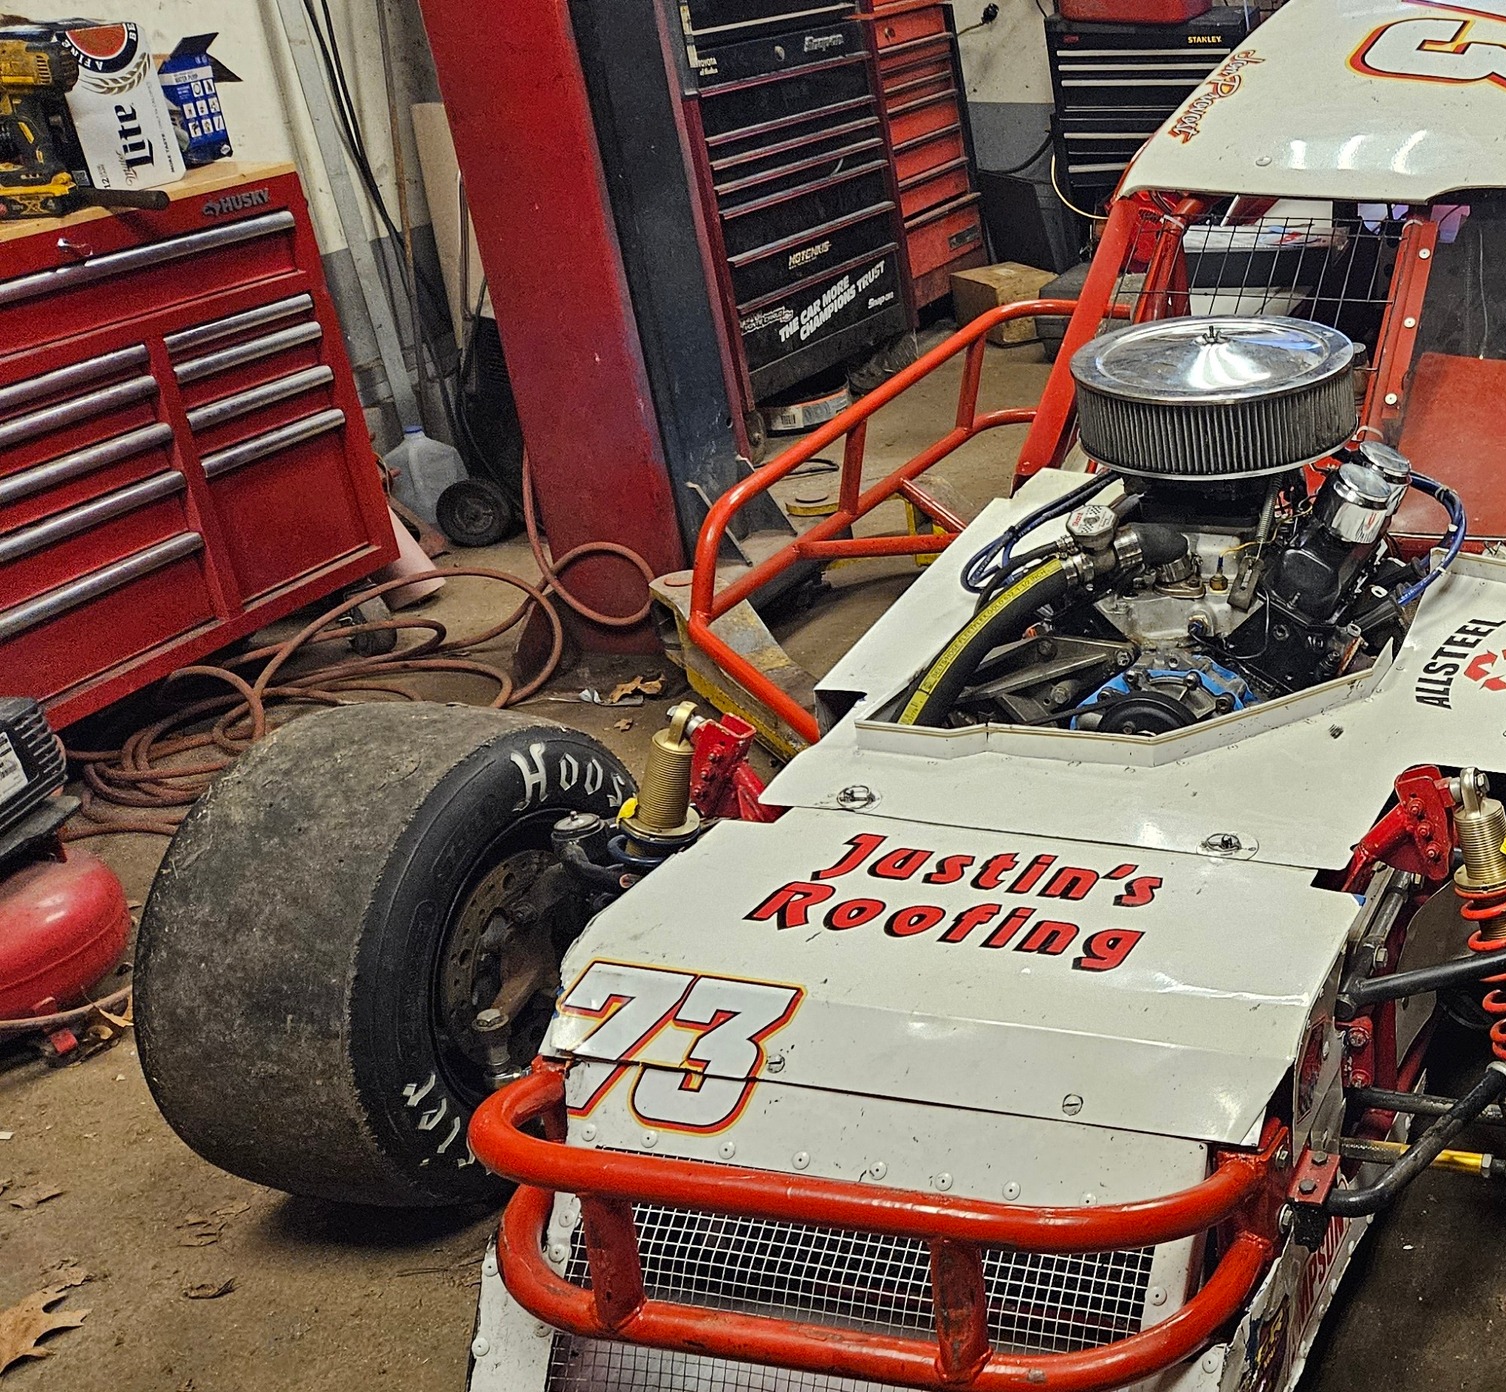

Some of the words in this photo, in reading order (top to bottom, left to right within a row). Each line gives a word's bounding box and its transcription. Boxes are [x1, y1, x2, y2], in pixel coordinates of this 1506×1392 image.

[126, 22, 138, 42] BE
[1187, 35, 1222, 44] STANLEY
[113, 103, 155, 169] Lite
[219, 187, 270, 214] HUSKY
[778, 317, 800, 343] THE
[800, 299, 821, 325] CAR
[822, 275, 850, 307] MORE
[800, 284, 857, 341] CHAMPIONS
[856, 260, 886, 293] TRUST
[810, 832, 1163, 908] Justin's
[743, 880, 1146, 973] Roofing
[555, 956, 808, 1136] 73
